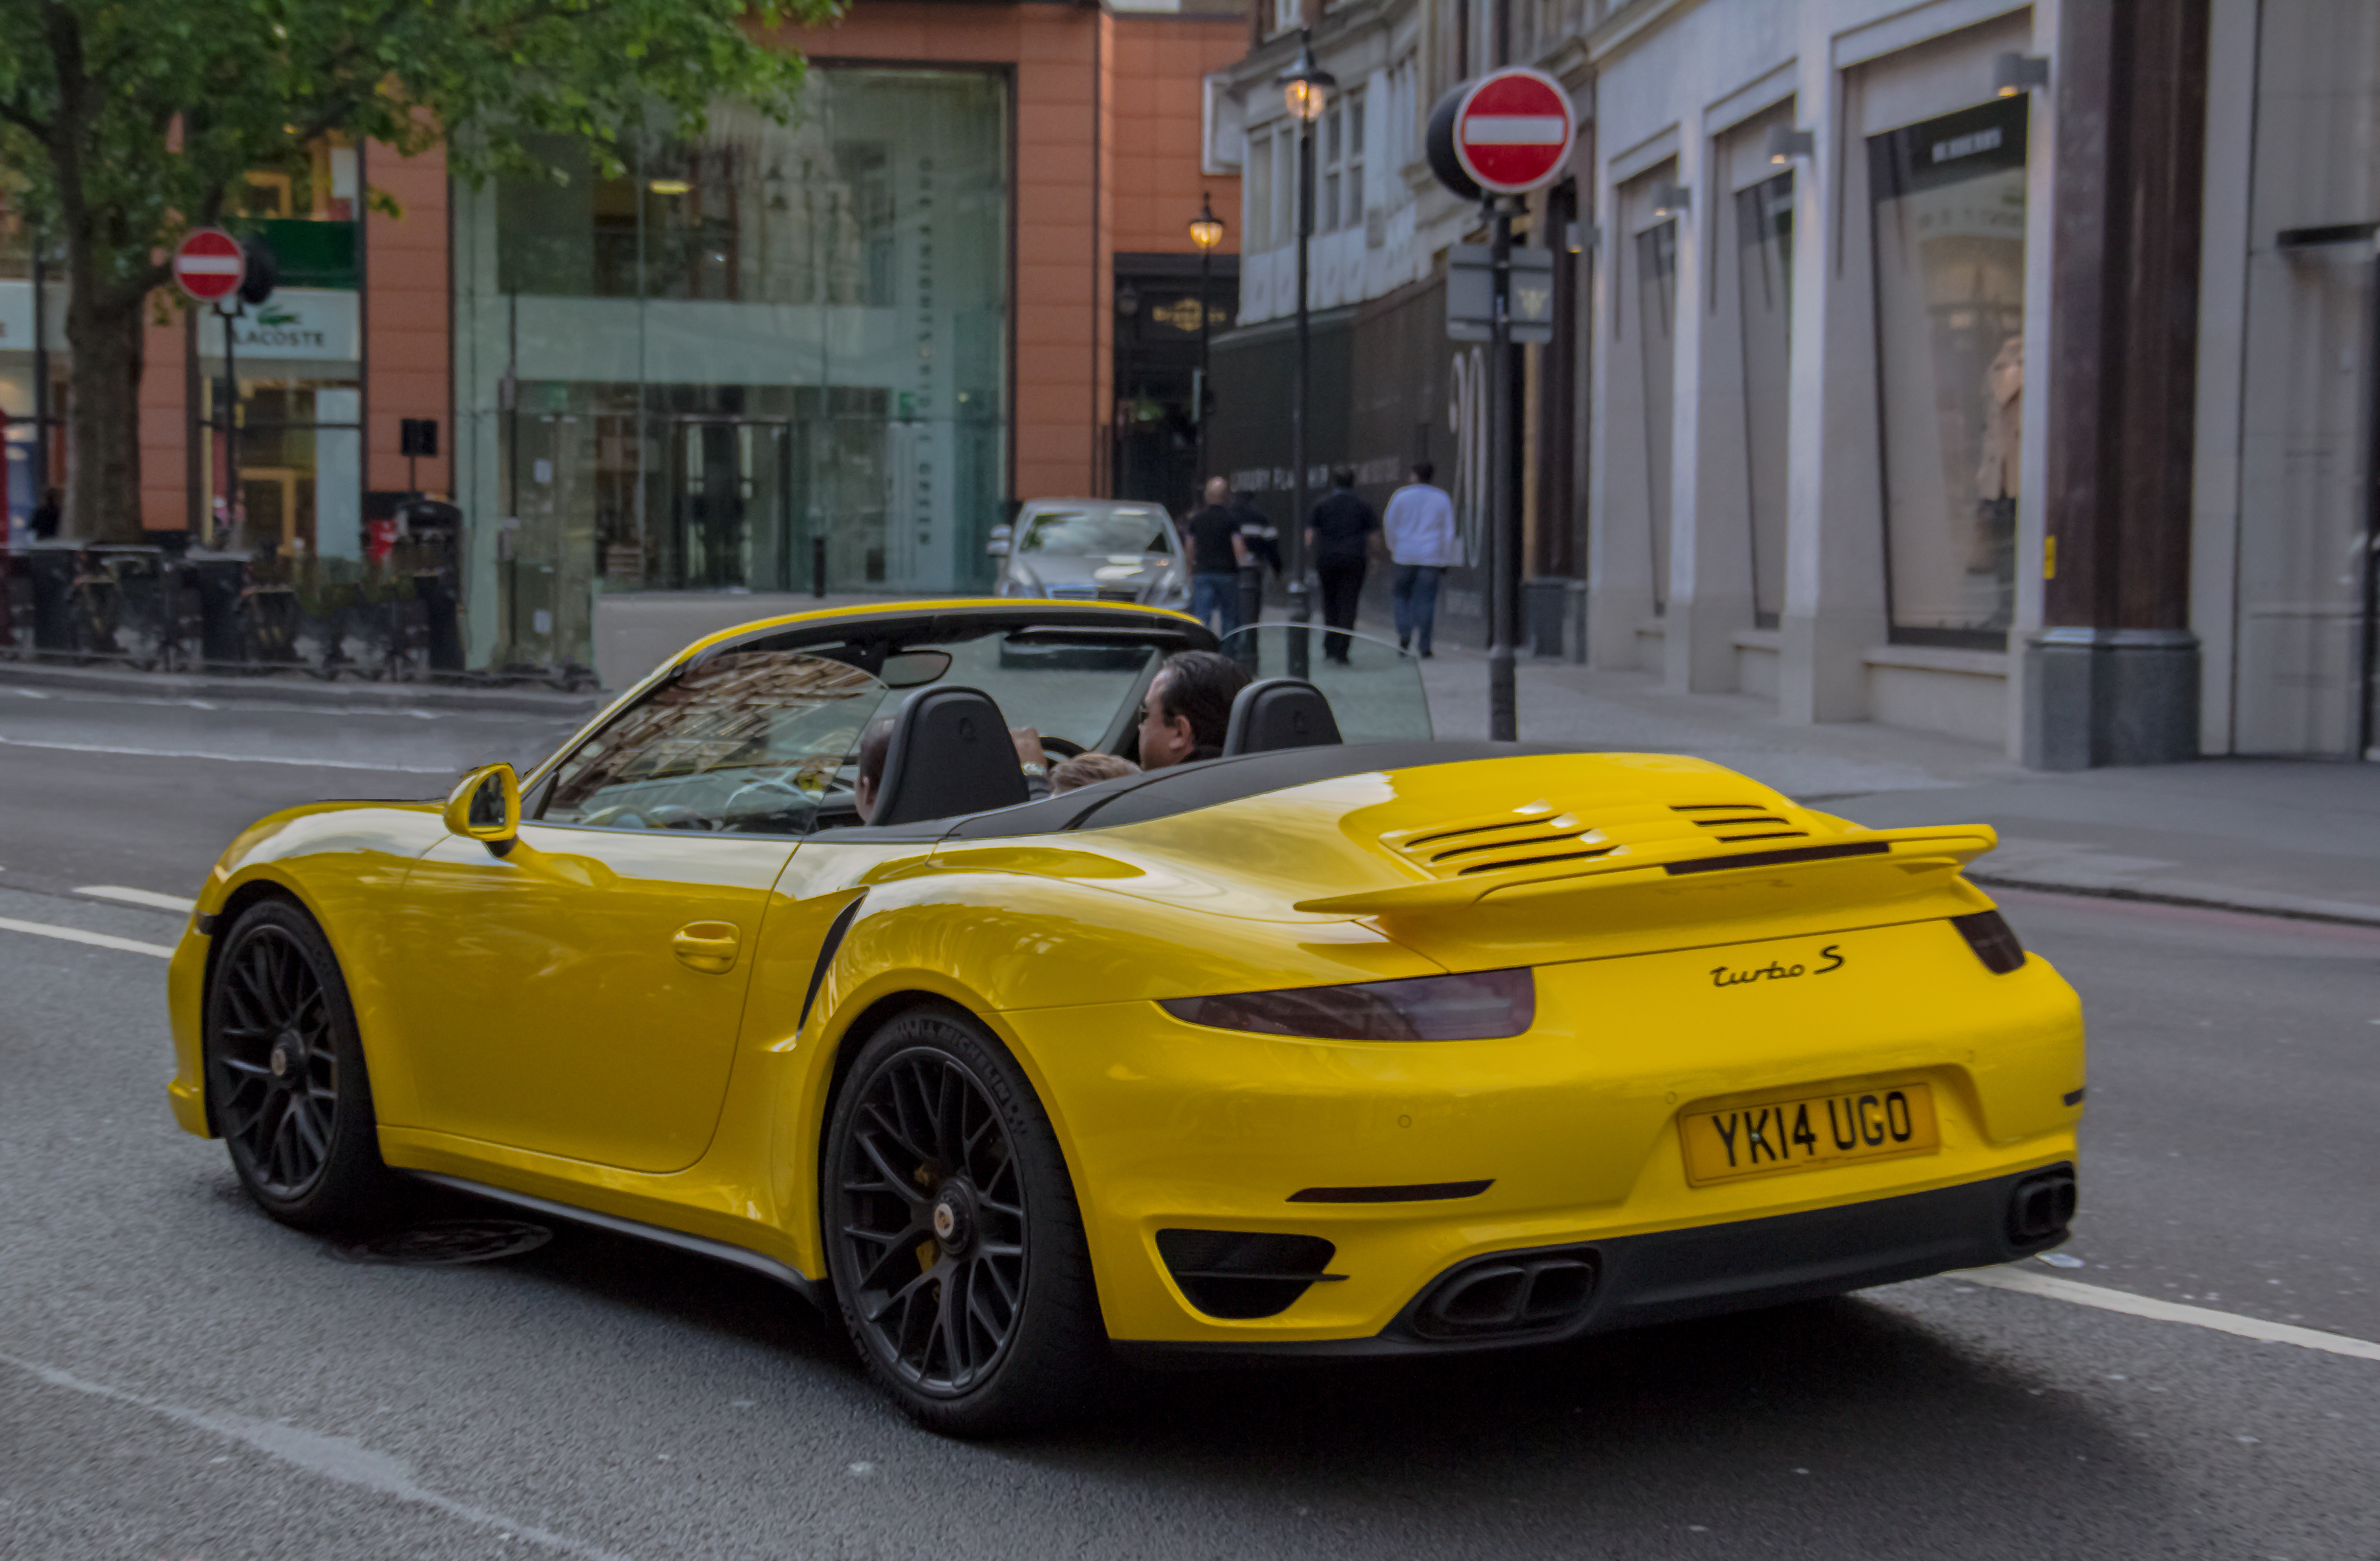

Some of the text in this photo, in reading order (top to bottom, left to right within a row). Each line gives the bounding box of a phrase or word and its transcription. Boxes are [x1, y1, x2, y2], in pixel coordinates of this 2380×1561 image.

[1709, 944, 1846, 988] turbo S
[1711, 1090, 1913, 1168] YK14 UGO
